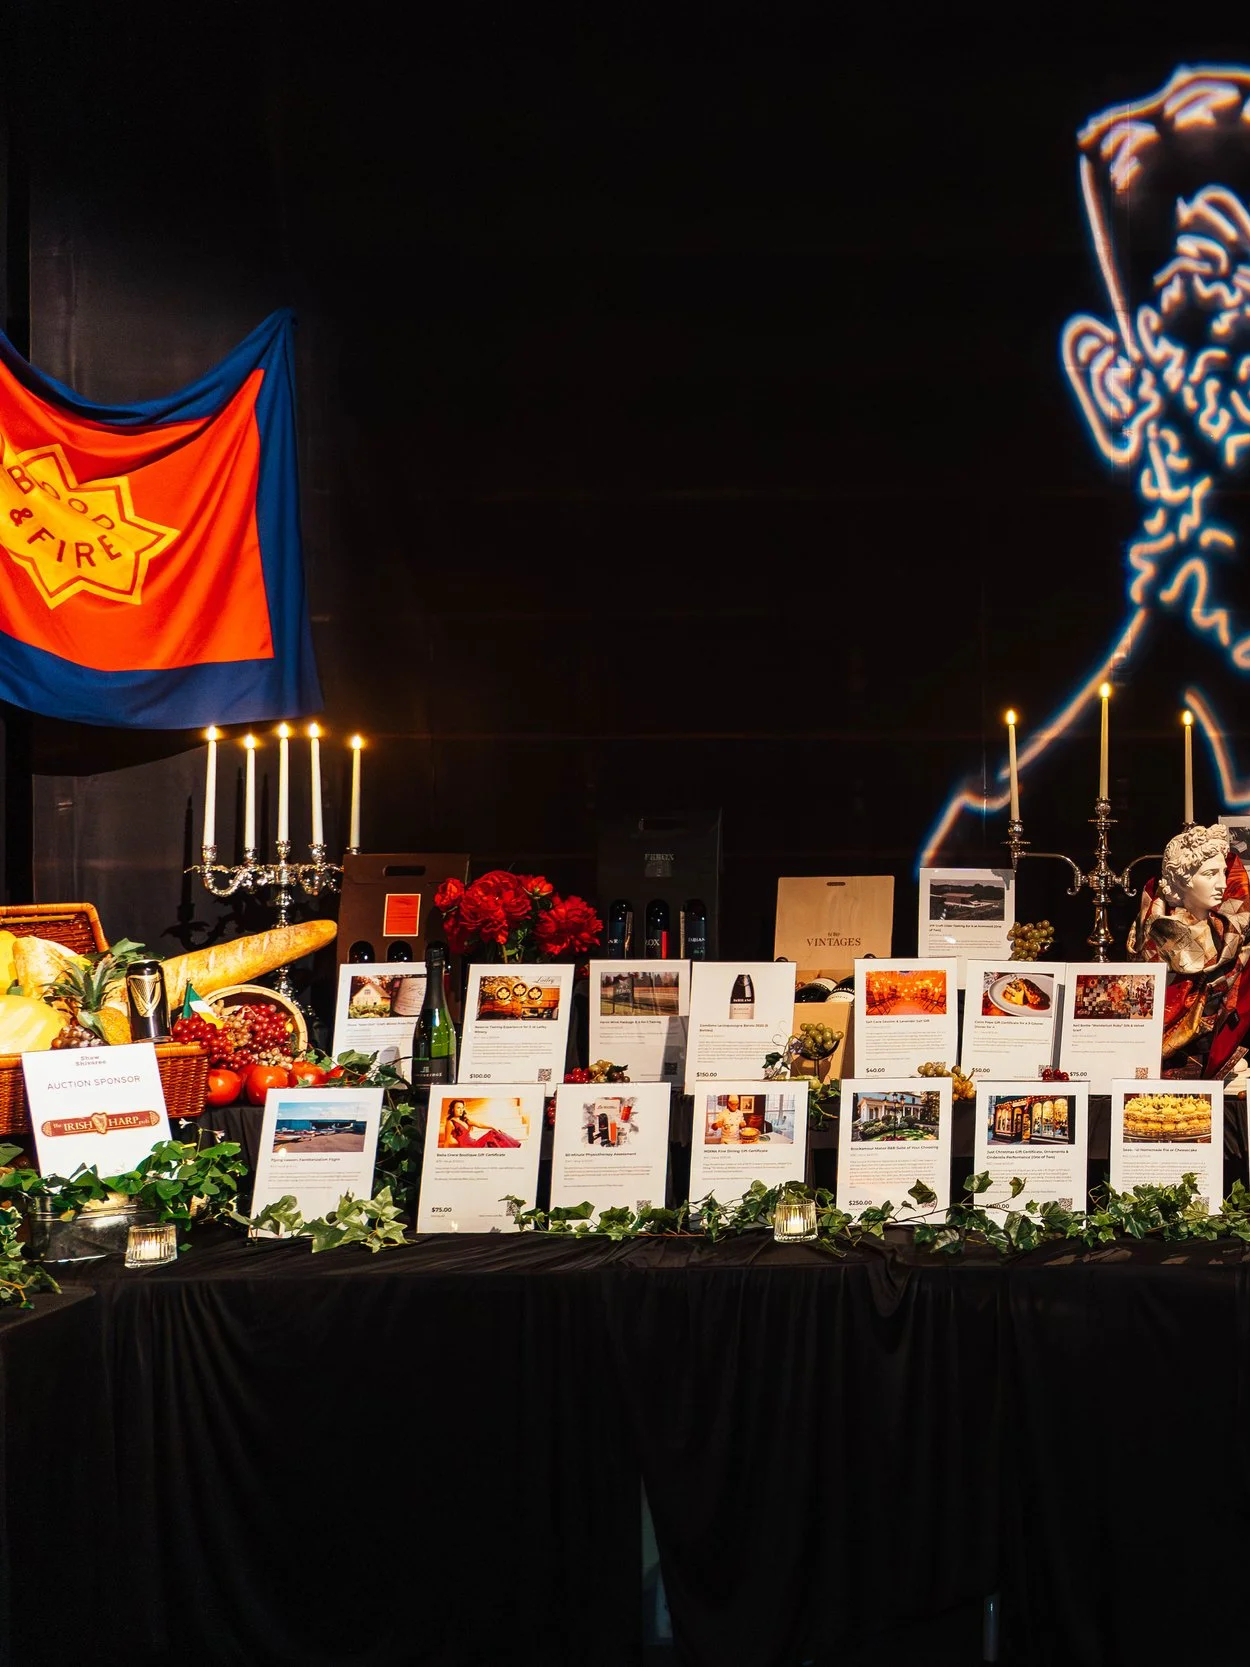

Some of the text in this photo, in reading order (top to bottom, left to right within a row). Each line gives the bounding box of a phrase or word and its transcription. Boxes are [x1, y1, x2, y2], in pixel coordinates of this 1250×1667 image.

[9, 507, 122, 568] & FIRE
[806, 937, 861, 947] VINTAGES
[48, 1075, 141, 1090] AUCTION SPONSOR
[64, 1121, 93, 1131] IRISH
[109, 1116, 139, 1127] HARP
